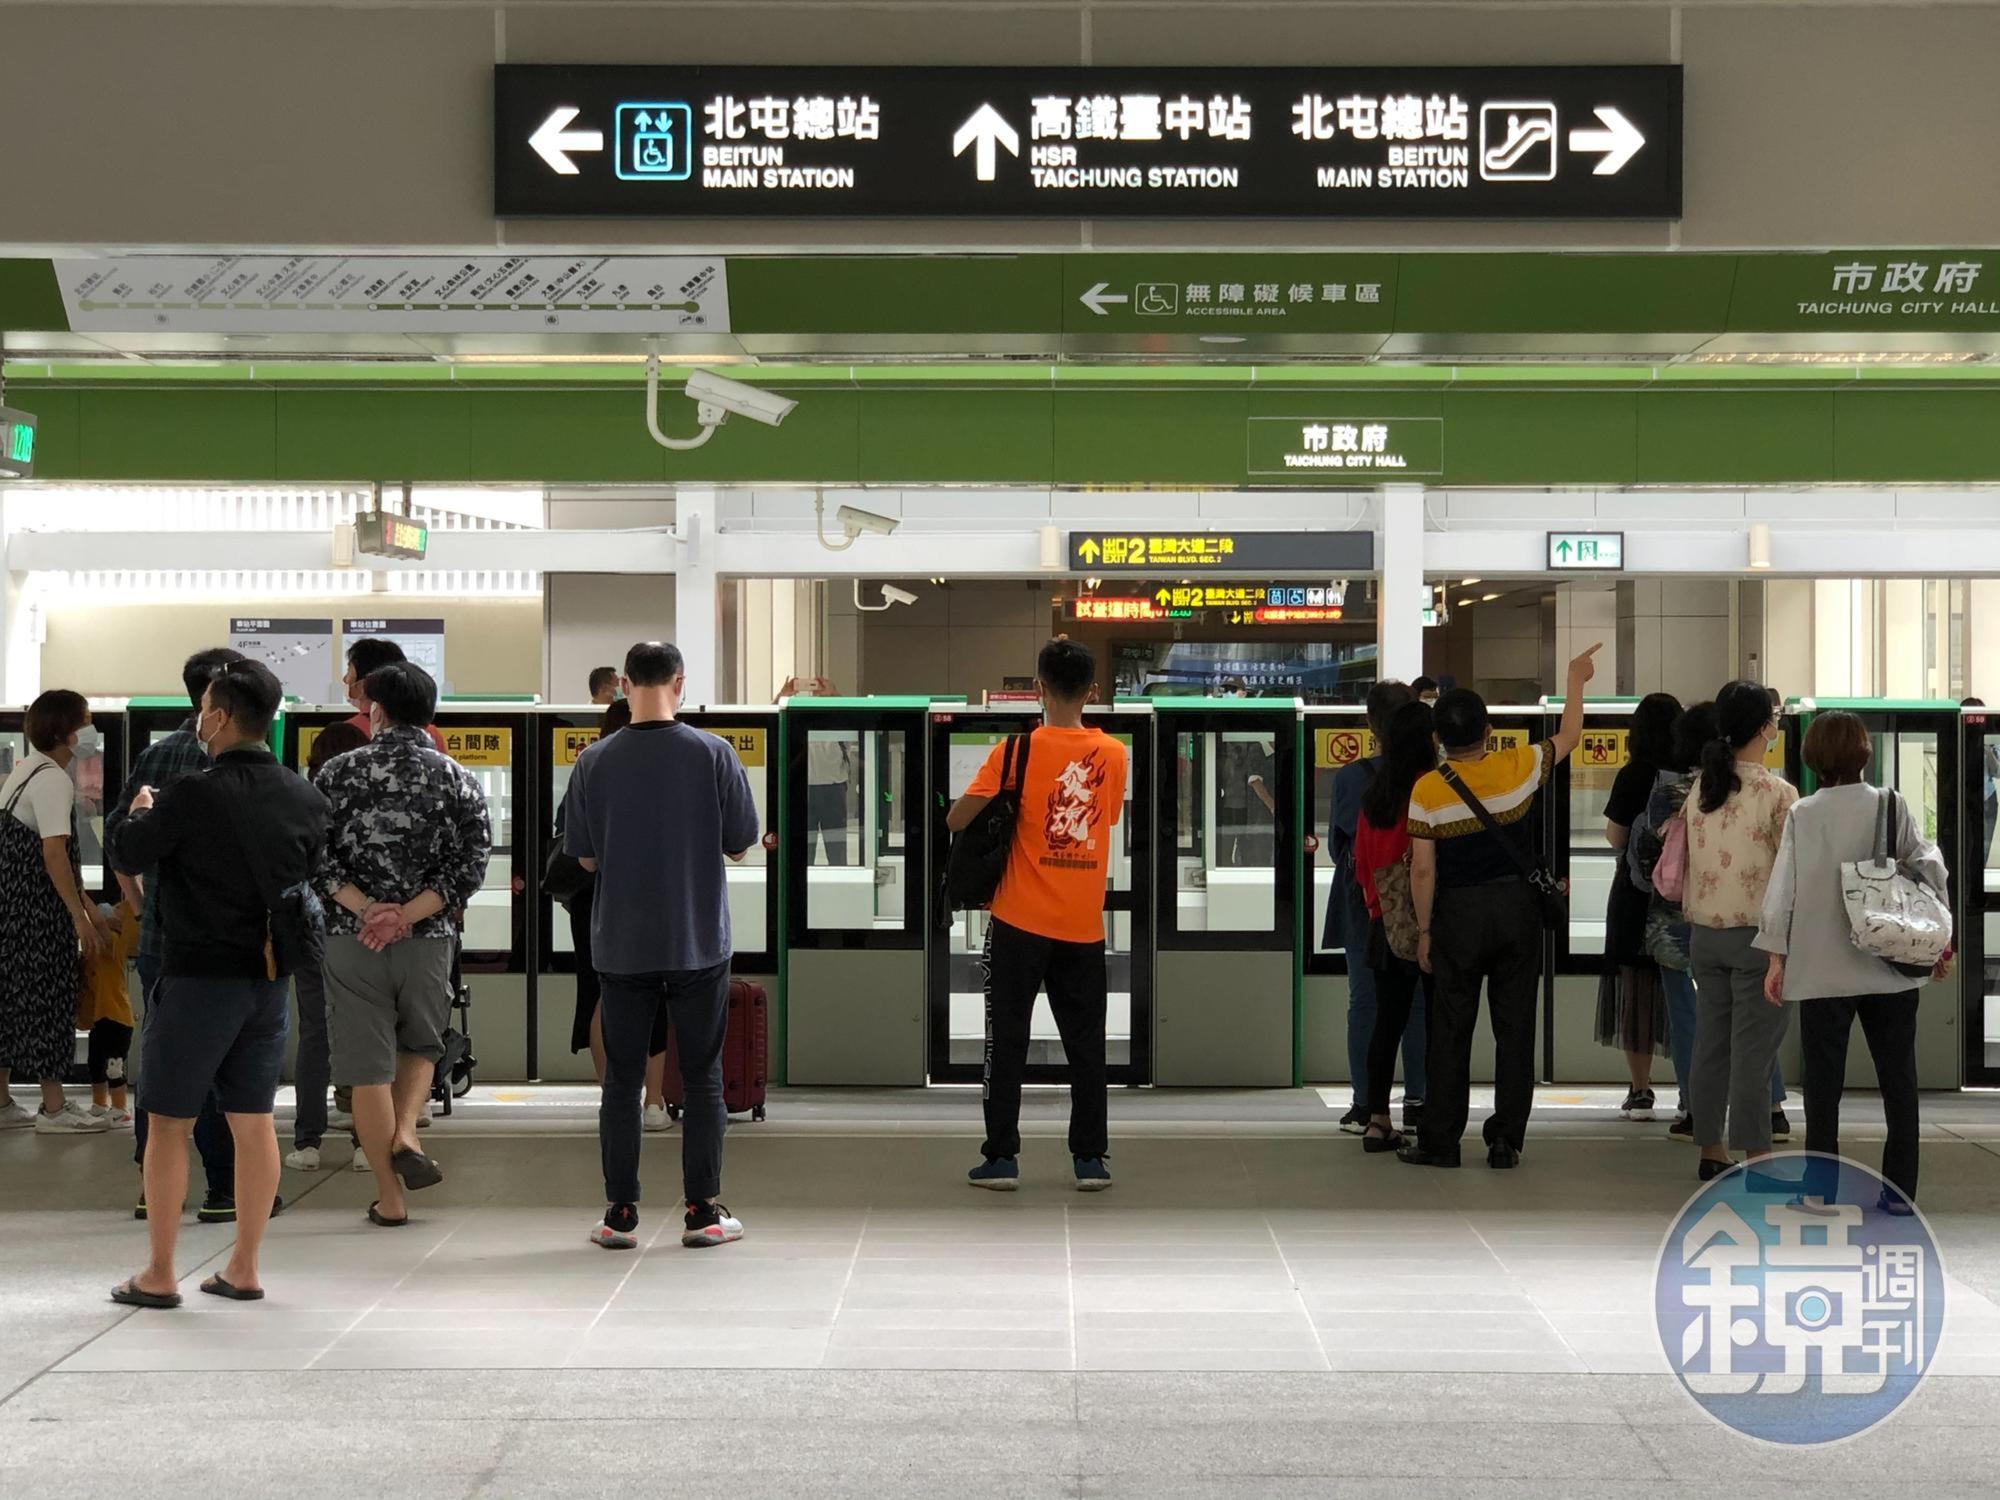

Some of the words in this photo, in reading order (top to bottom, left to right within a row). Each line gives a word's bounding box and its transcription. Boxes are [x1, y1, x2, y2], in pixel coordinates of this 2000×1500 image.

[704, 95, 880, 140] 北屯總站
[1031, 94, 1252, 141] 高鐵臺中站
[1291, 94, 1469, 141] 北屯總站
[703, 145, 784, 166] BEITUN
[1030, 145, 1078, 166] HSR
[1388, 145, 1469, 166] BEITUN
[703, 168, 759, 188] MAIN
[764, 168, 854, 188] STATION
[1030, 168, 1142, 188] TAICHUNG
[1147, 168, 1239, 188] STATION
[1317, 168, 1373, 188] MAIN
[1377, 168, 1469, 188] STATION
[1832, 262, 1983, 294] 市政府
[1185, 283, 1382, 303] 無障礙候車區
[1185, 307, 1253, 316] ACCESSIBLE
[1256, 307, 1287, 316] AREA
[1797, 302, 1893, 314] TAICHUNG
[1900, 302, 1944, 314] CITY
[1950, 302, 2000, 314] HALL
[1302, 423, 1388, 452] 市政府
[1284, 455, 1343, 467] TAICHUNG
[1345, 455, 1373, 467] CITY
[1376, 455, 1407, 467] HALL
[1102, 538, 1127, 553] 出口
[1128, 538, 1146, 563] 2
[1149, 538, 1234, 554] 臺灣大道二段
[1102, 553, 1127, 563] EXIT
[1149, 555, 1176, 563] TAIWAN
[1191, 588, 1204, 606] 2
